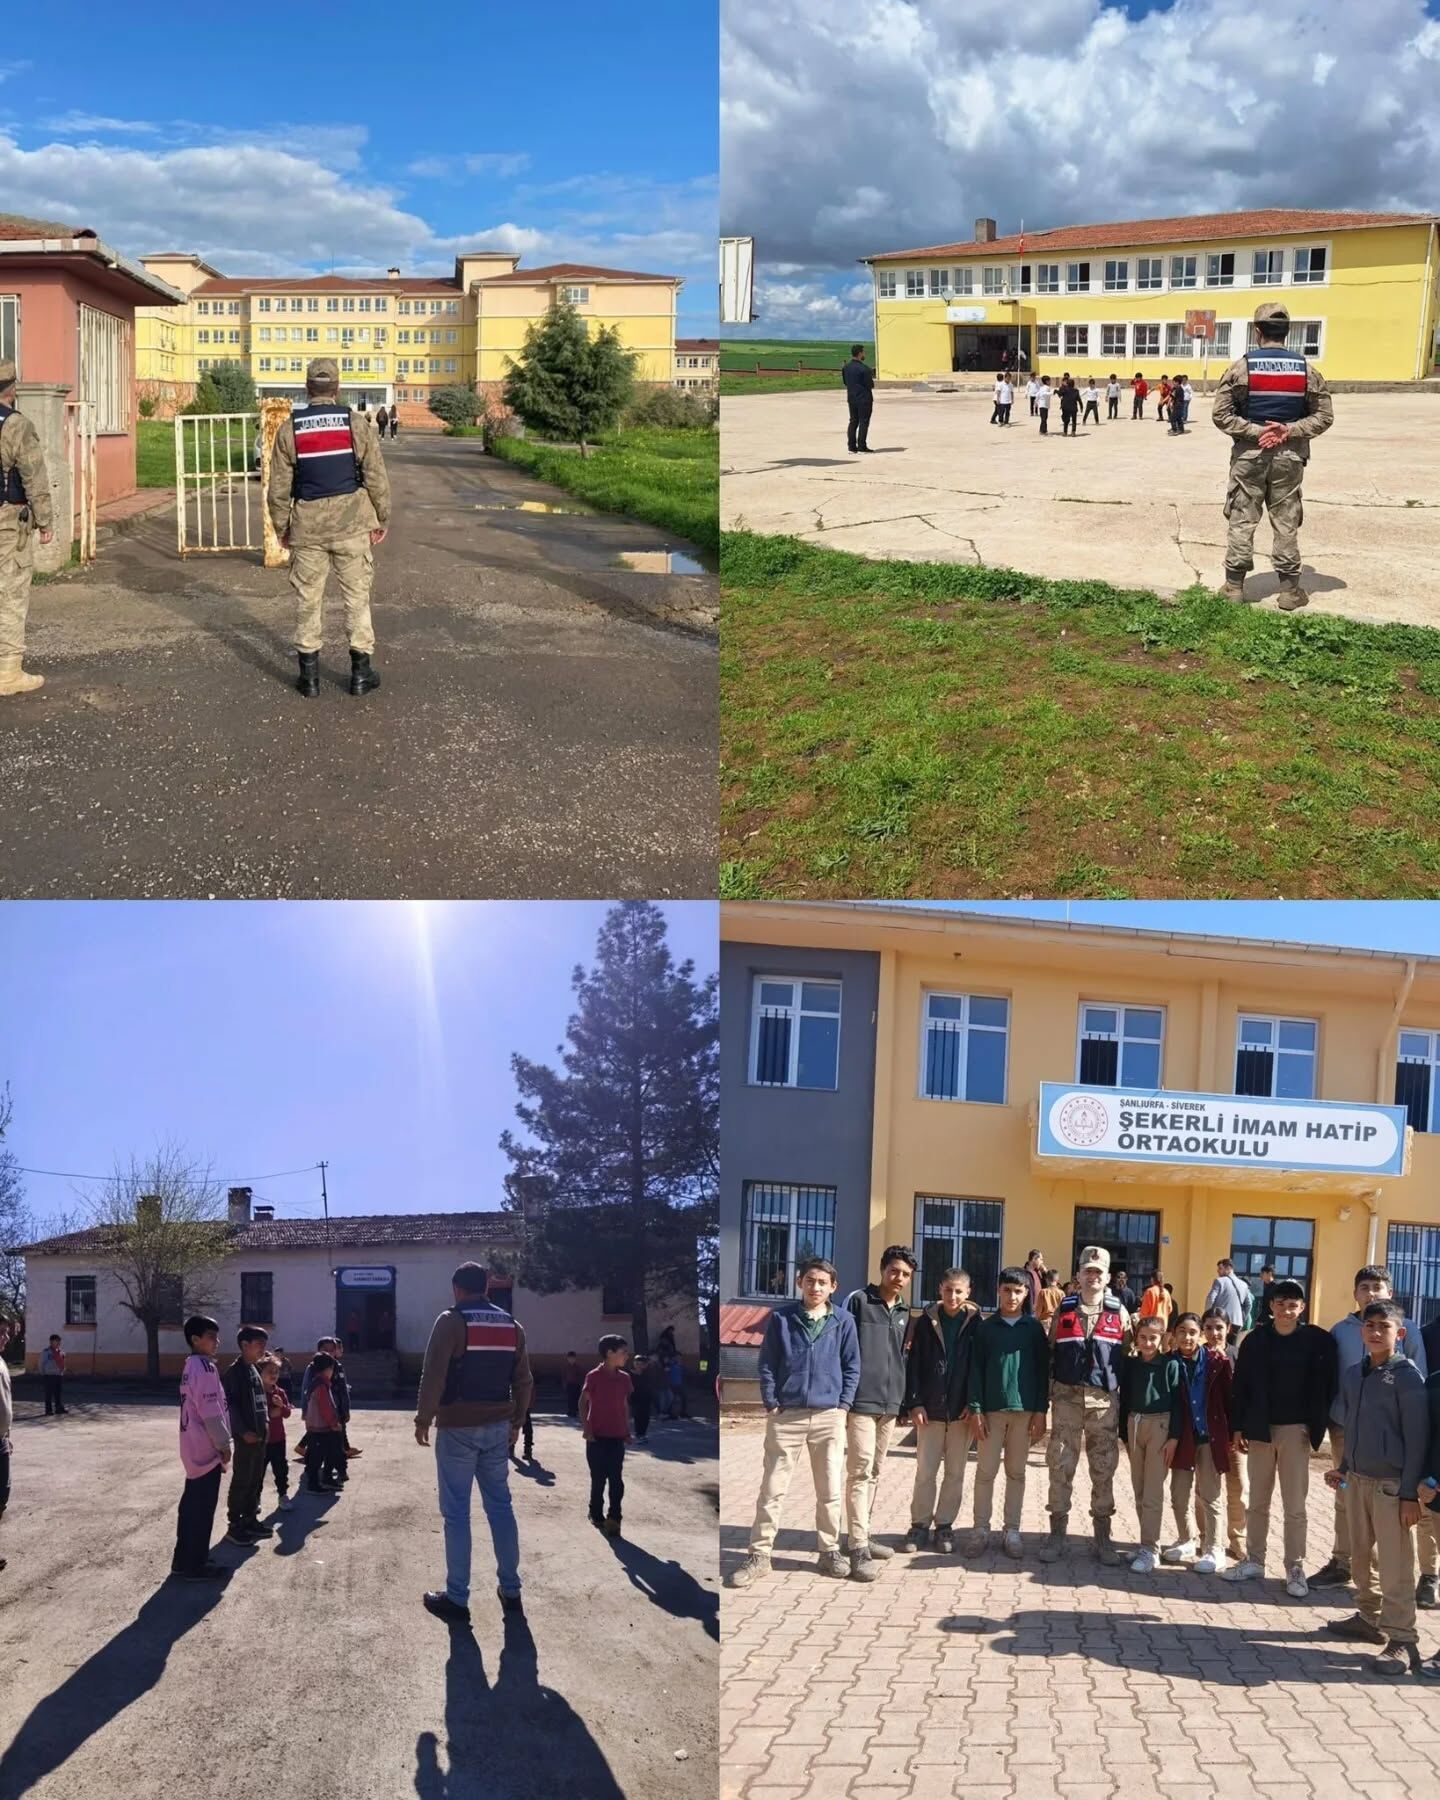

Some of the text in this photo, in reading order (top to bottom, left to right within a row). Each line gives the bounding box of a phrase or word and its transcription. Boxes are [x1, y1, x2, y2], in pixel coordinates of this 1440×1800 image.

[1254, 360, 1301, 372] JANDARMA
[300, 416, 345, 430] JANDARMA
[1119, 1099, 1165, 1110] ŞANLIURFA
[1171, 1100, 1206, 1112] SİVEREK
[1118, 1111, 1224, 1133] ŞEKERLİ
[1232, 1114, 1298, 1137] İMAM
[1305, 1121, 1378, 1142] HATİP
[1117, 1133, 1269, 1157] ORTAOKULU
